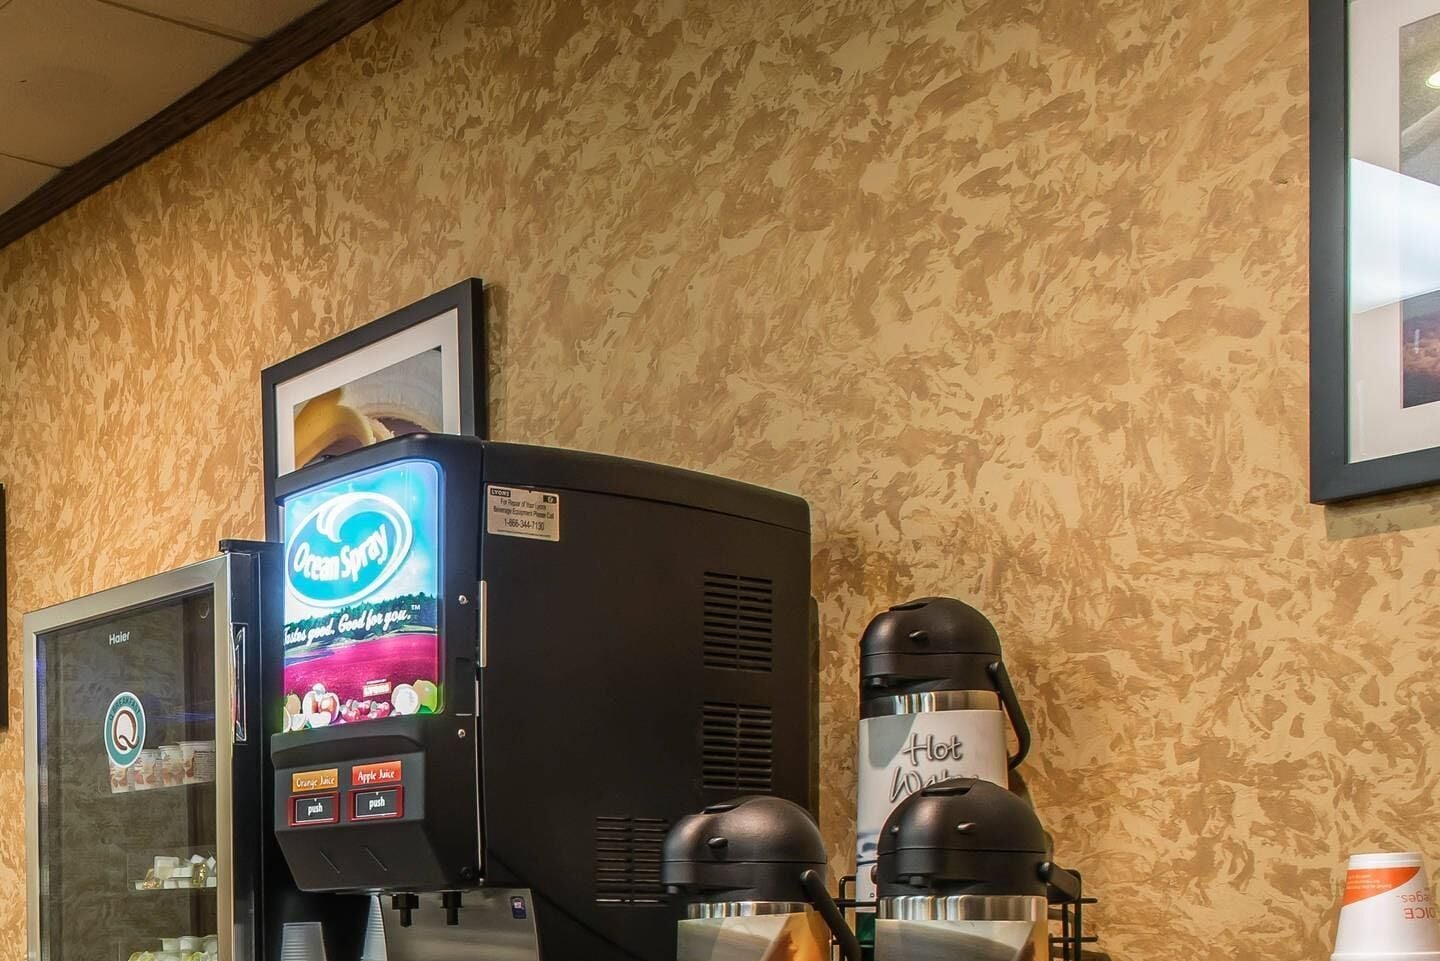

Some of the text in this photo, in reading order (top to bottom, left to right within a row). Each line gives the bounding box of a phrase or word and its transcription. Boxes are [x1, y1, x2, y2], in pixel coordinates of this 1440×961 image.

[294, 523, 388, 582] Ocean Spray
[306, 618, 335, 646] good.
[338, 610, 366, 633] Good
[365, 608, 383, 631] for
[109, 631, 130, 645] Haier
[903, 732, 963, 766] Hot
[296, 776, 335, 789] Orange Juice
[358, 768, 395, 784] Apple Juice
[308, 803, 323, 816] push
[369, 796, 385, 810] push
